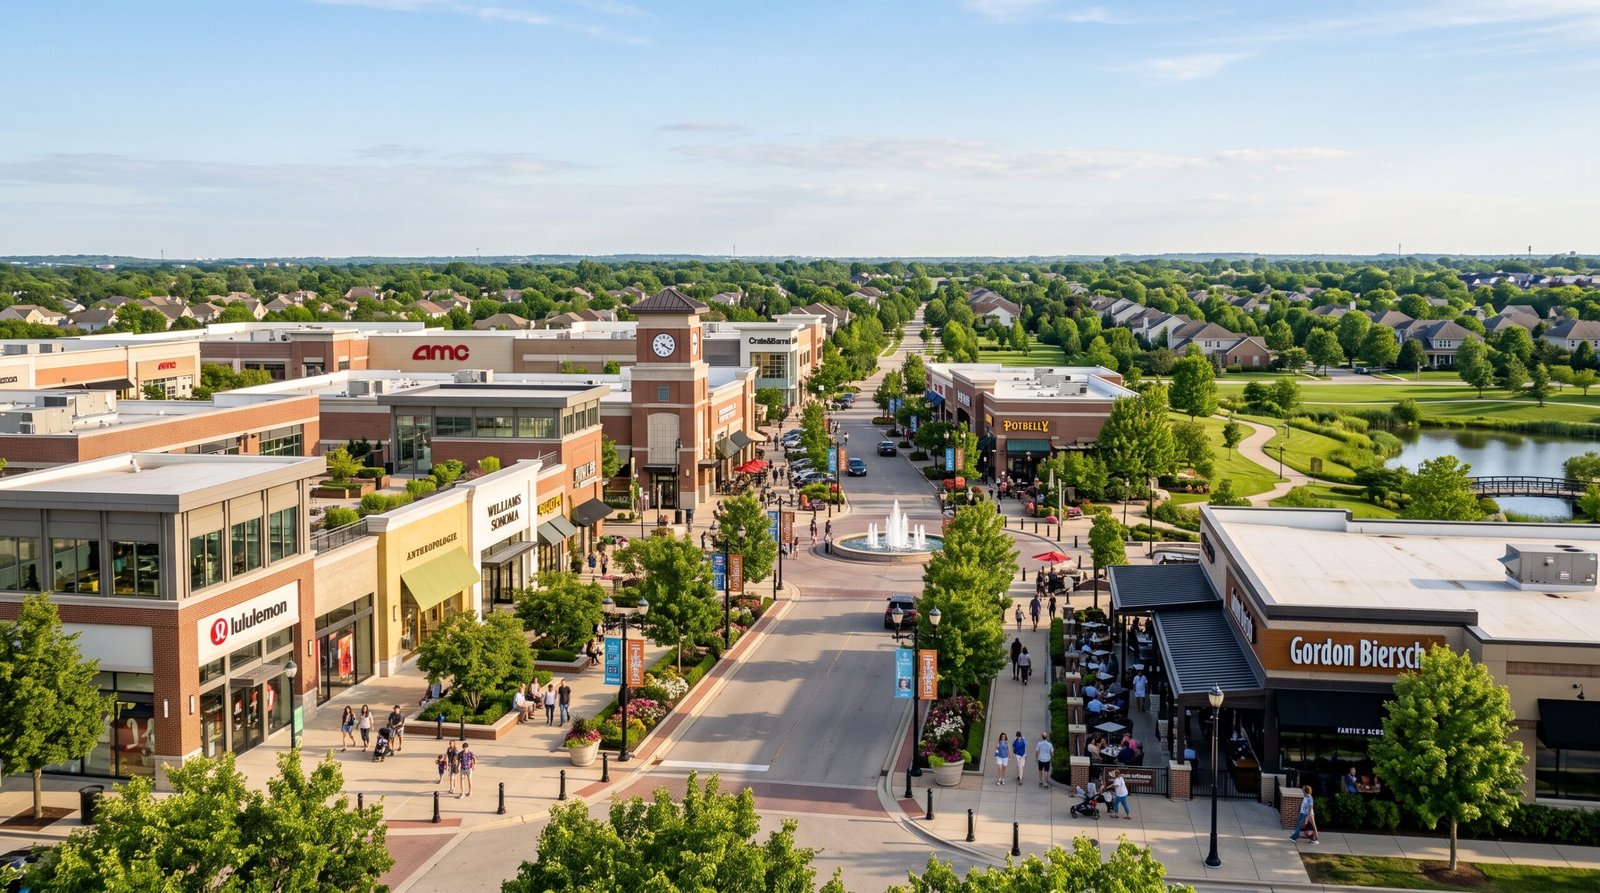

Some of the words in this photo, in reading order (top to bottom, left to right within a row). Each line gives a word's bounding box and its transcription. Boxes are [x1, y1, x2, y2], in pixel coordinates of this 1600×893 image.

[749, 337, 791, 345] Crate&Barrel
[1003, 420, 1049, 432] POTBELLY
[487, 493, 522, 518] WILLIAMS
[491, 509, 519, 531] SONOMA
[406, 532, 458, 561] ANTHROPOLOGIE
[231, 600, 288, 636] lululemon
[1290, 636, 1355, 666] Gordon
[1360, 639, 1425, 669] Biersch
